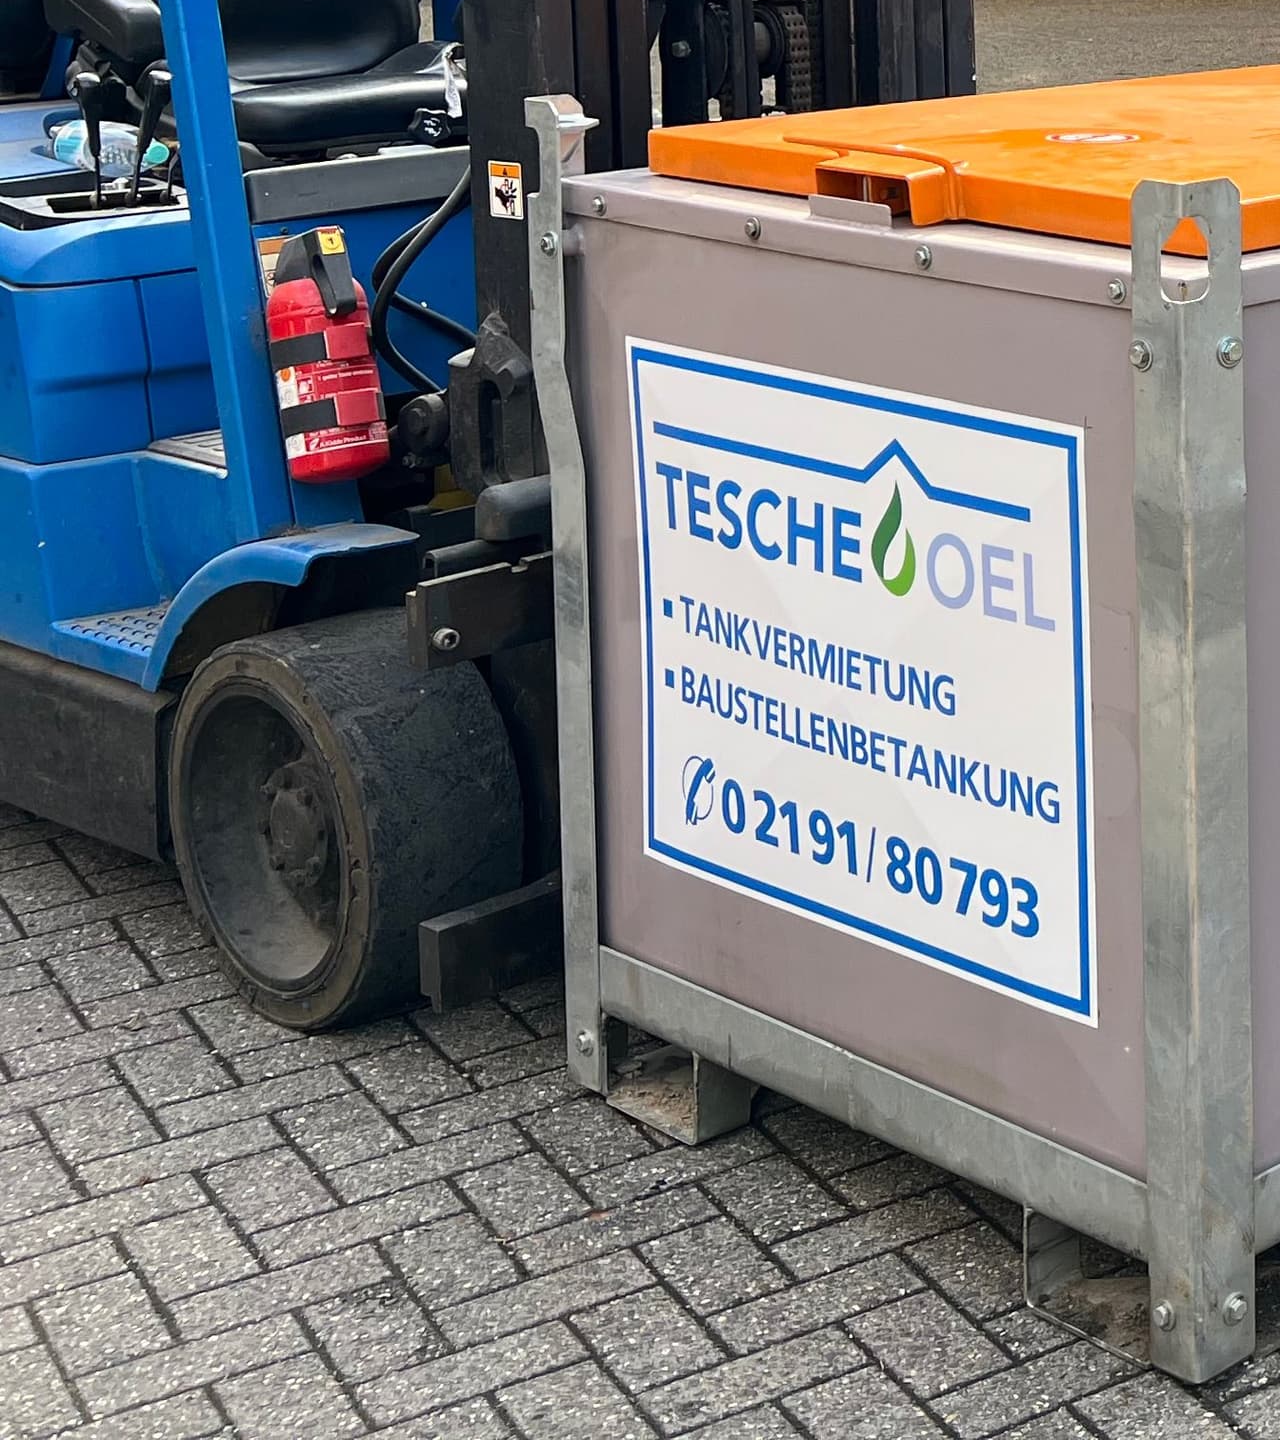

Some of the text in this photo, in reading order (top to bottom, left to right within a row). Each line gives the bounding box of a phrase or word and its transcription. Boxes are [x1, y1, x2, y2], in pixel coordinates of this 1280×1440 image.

[655, 461, 1056, 633] TESCHE OEL
[679, 595, 956, 716] TANKVERMIETUNG
[681, 666, 1062, 824] BAUSTELLENBETANKUNG
